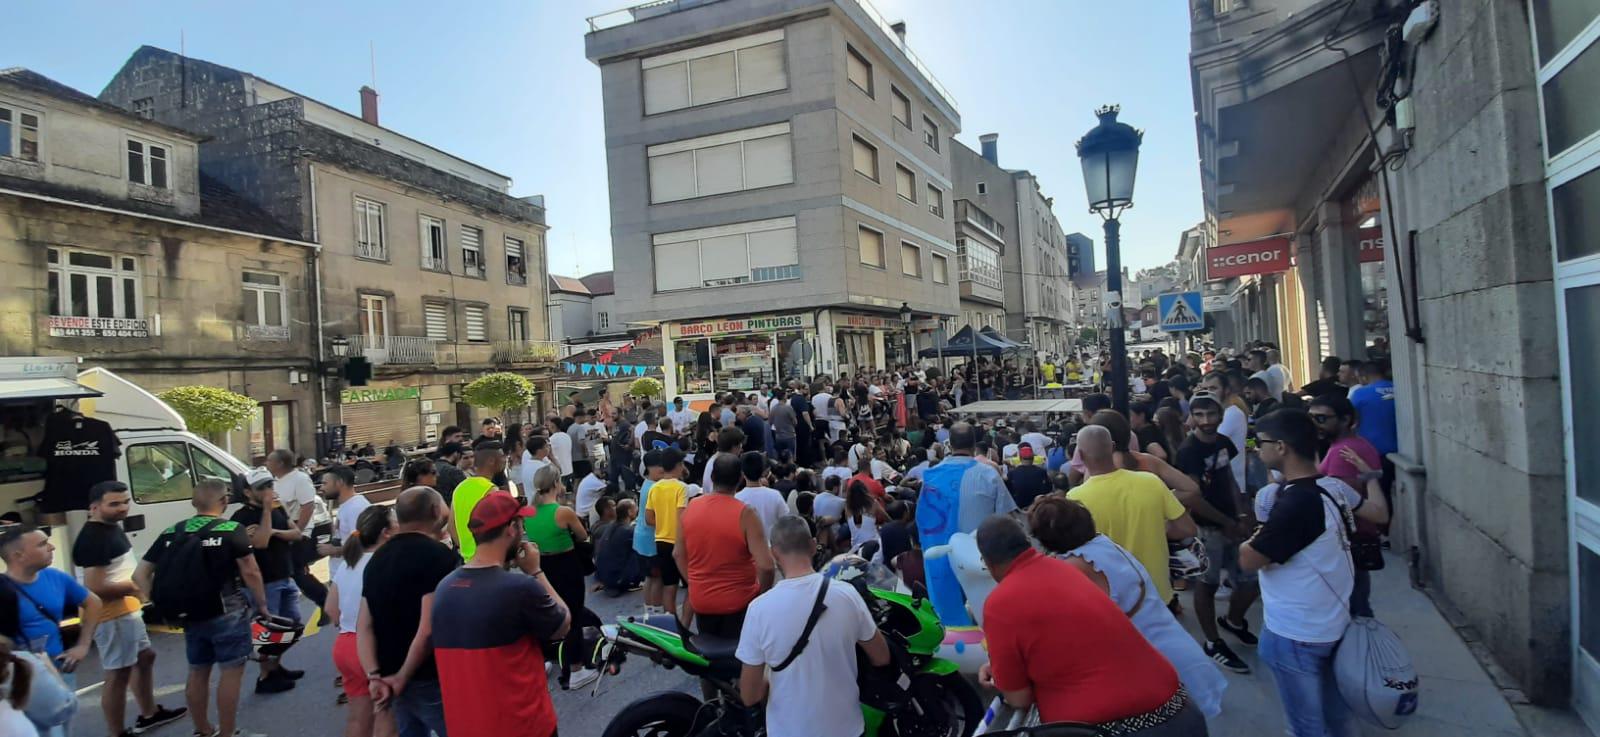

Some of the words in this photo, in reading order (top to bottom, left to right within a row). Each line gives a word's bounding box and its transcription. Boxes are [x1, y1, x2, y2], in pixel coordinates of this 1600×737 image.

[1226, 250, 1281, 266] cenor
[49, 317, 60, 328] SE
[61, 317, 89, 329] VENDE
[92, 318, 112, 329] ESTE
[113, 319, 147, 330] EDIFICIO
[680, 324, 713, 335] BARCO
[717, 321, 743, 332] LEON
[748, 316, 802, 329] PINTURAS
[340, 387, 418, 403] FARMACIA
[54, 449, 100, 457] HONDA
